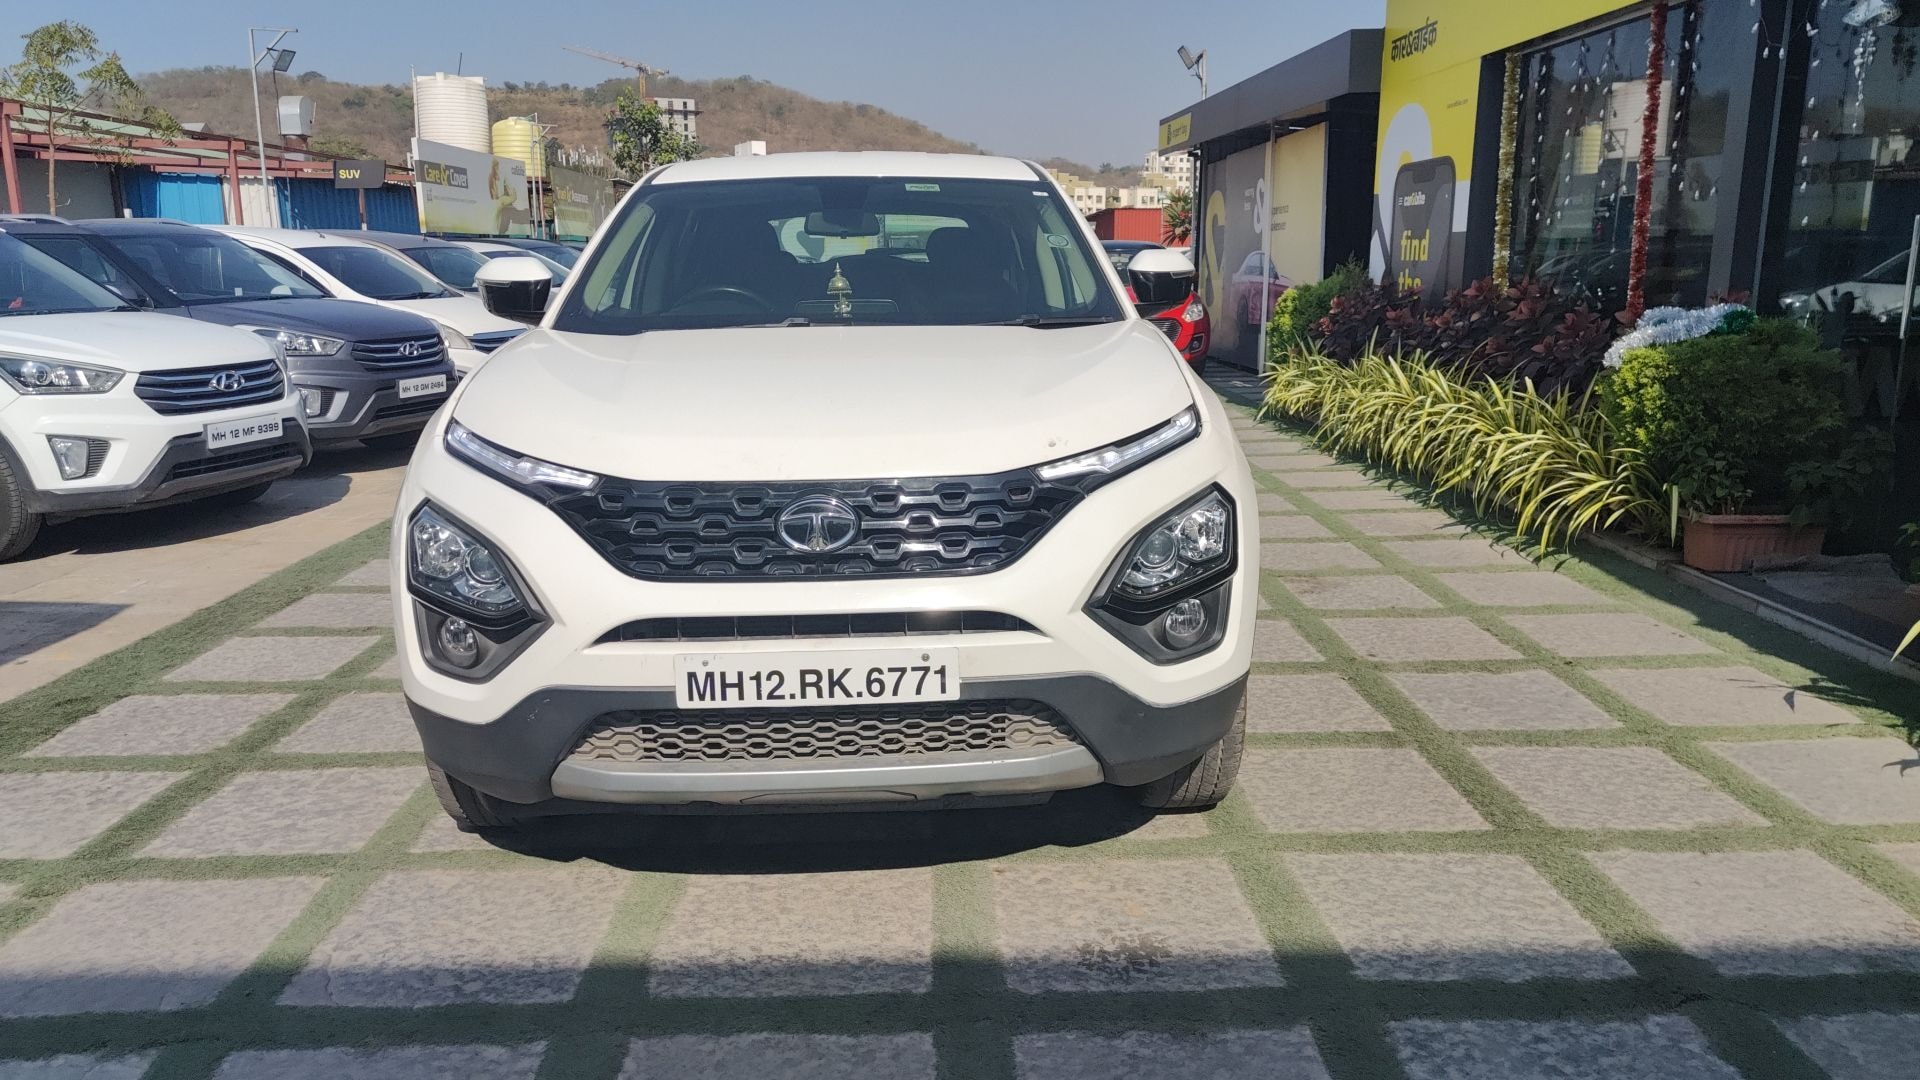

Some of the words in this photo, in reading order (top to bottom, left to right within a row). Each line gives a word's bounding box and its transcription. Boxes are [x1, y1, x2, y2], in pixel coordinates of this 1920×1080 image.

[339, 169, 360, 179] SUV
[450, 169, 468, 187] Cover
[1401, 228, 1430, 261] find
[212, 432, 226, 441] MH
[230, 429, 240, 438] 12
[242, 426, 255, 436] MF
[257, 422, 279, 434] 9399
[686, 664, 947, 702] MH12.RK.6771
